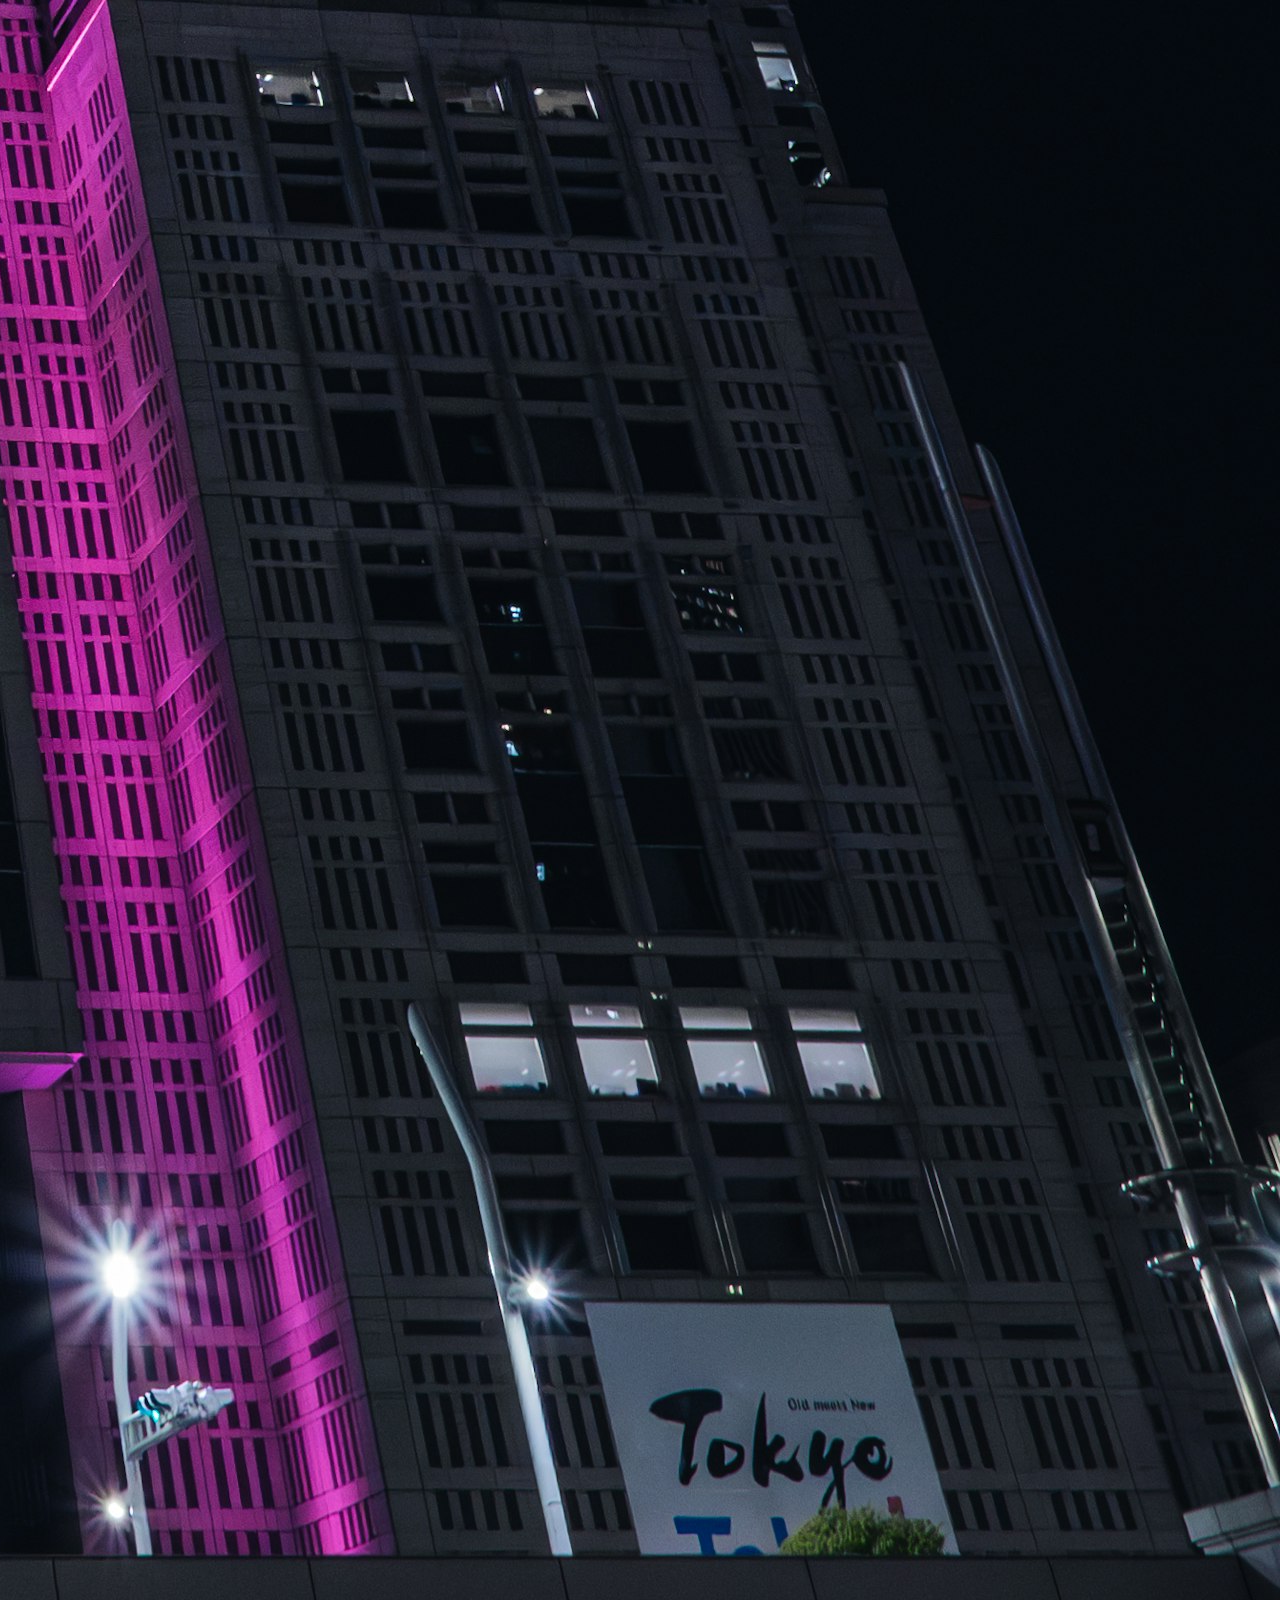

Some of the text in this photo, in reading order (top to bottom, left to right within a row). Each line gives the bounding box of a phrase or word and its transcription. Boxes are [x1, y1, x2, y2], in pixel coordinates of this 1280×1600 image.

[787, 1397, 810, 1411] Old
[851, 1398, 876, 1411] New
[649, 1388, 893, 1509] Tokyo
